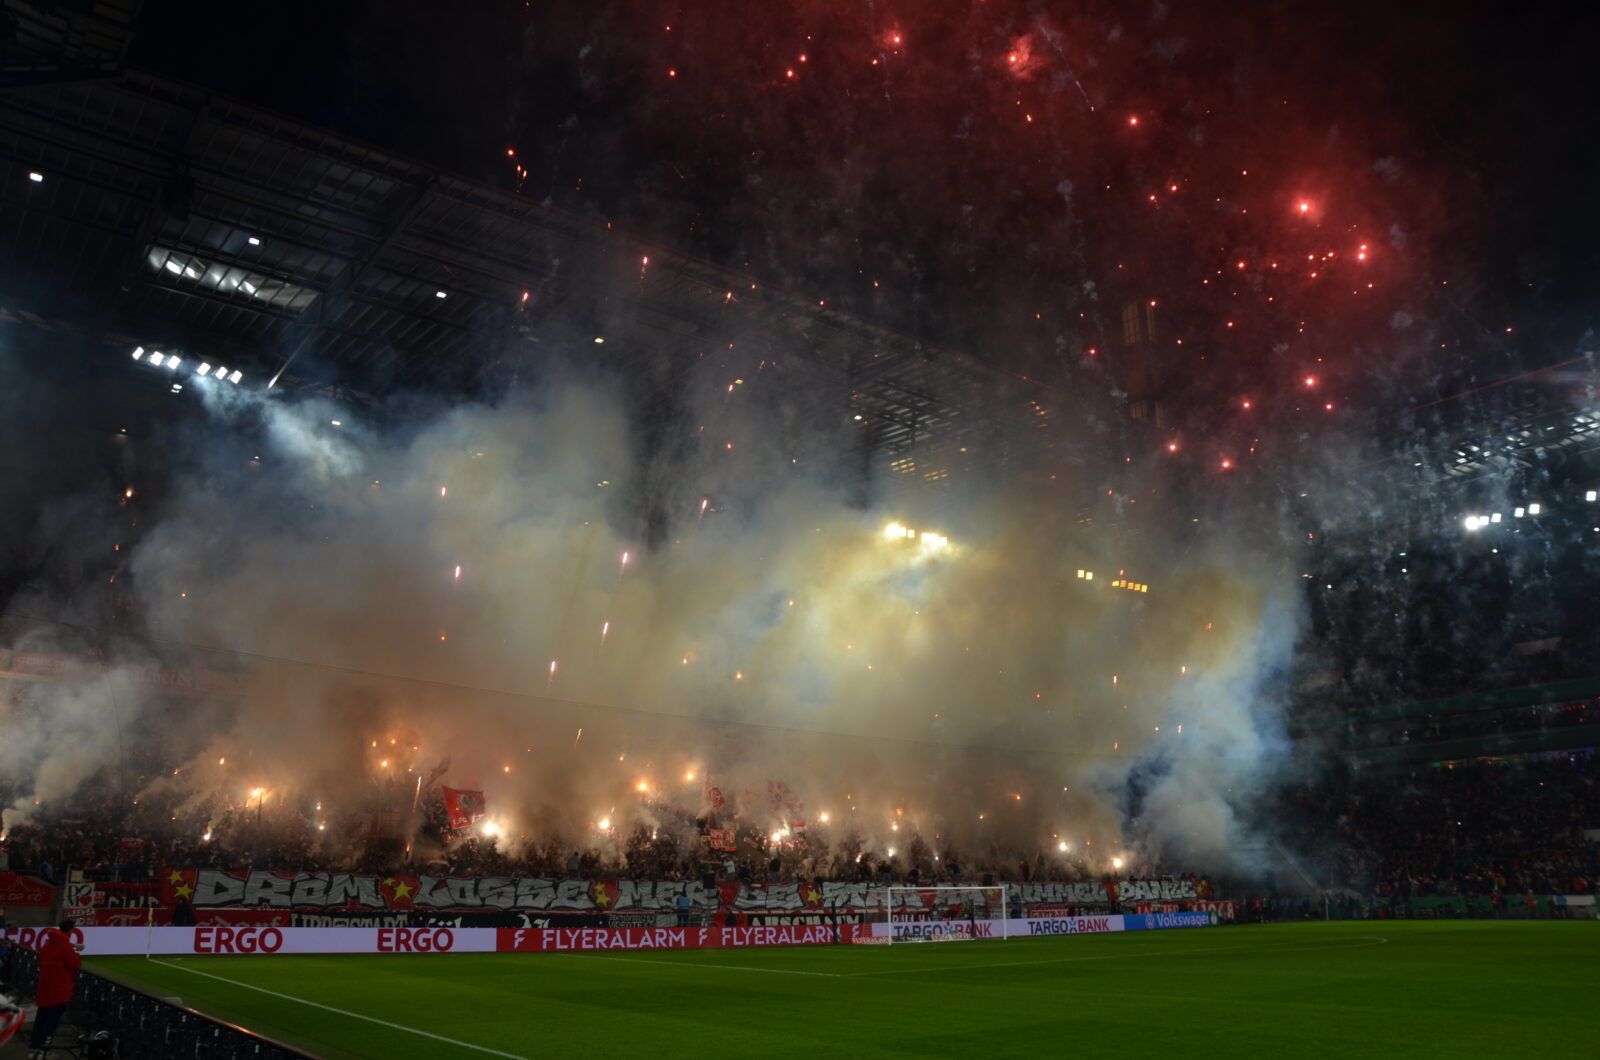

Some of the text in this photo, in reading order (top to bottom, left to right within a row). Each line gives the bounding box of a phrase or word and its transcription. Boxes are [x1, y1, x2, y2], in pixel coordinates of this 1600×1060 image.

[193, 928, 283, 953] ERGO
[377, 928, 454, 952] ERGO
[542, 928, 686, 949] FLYERALARM
[721, 925, 840, 946] FLYERALARM
